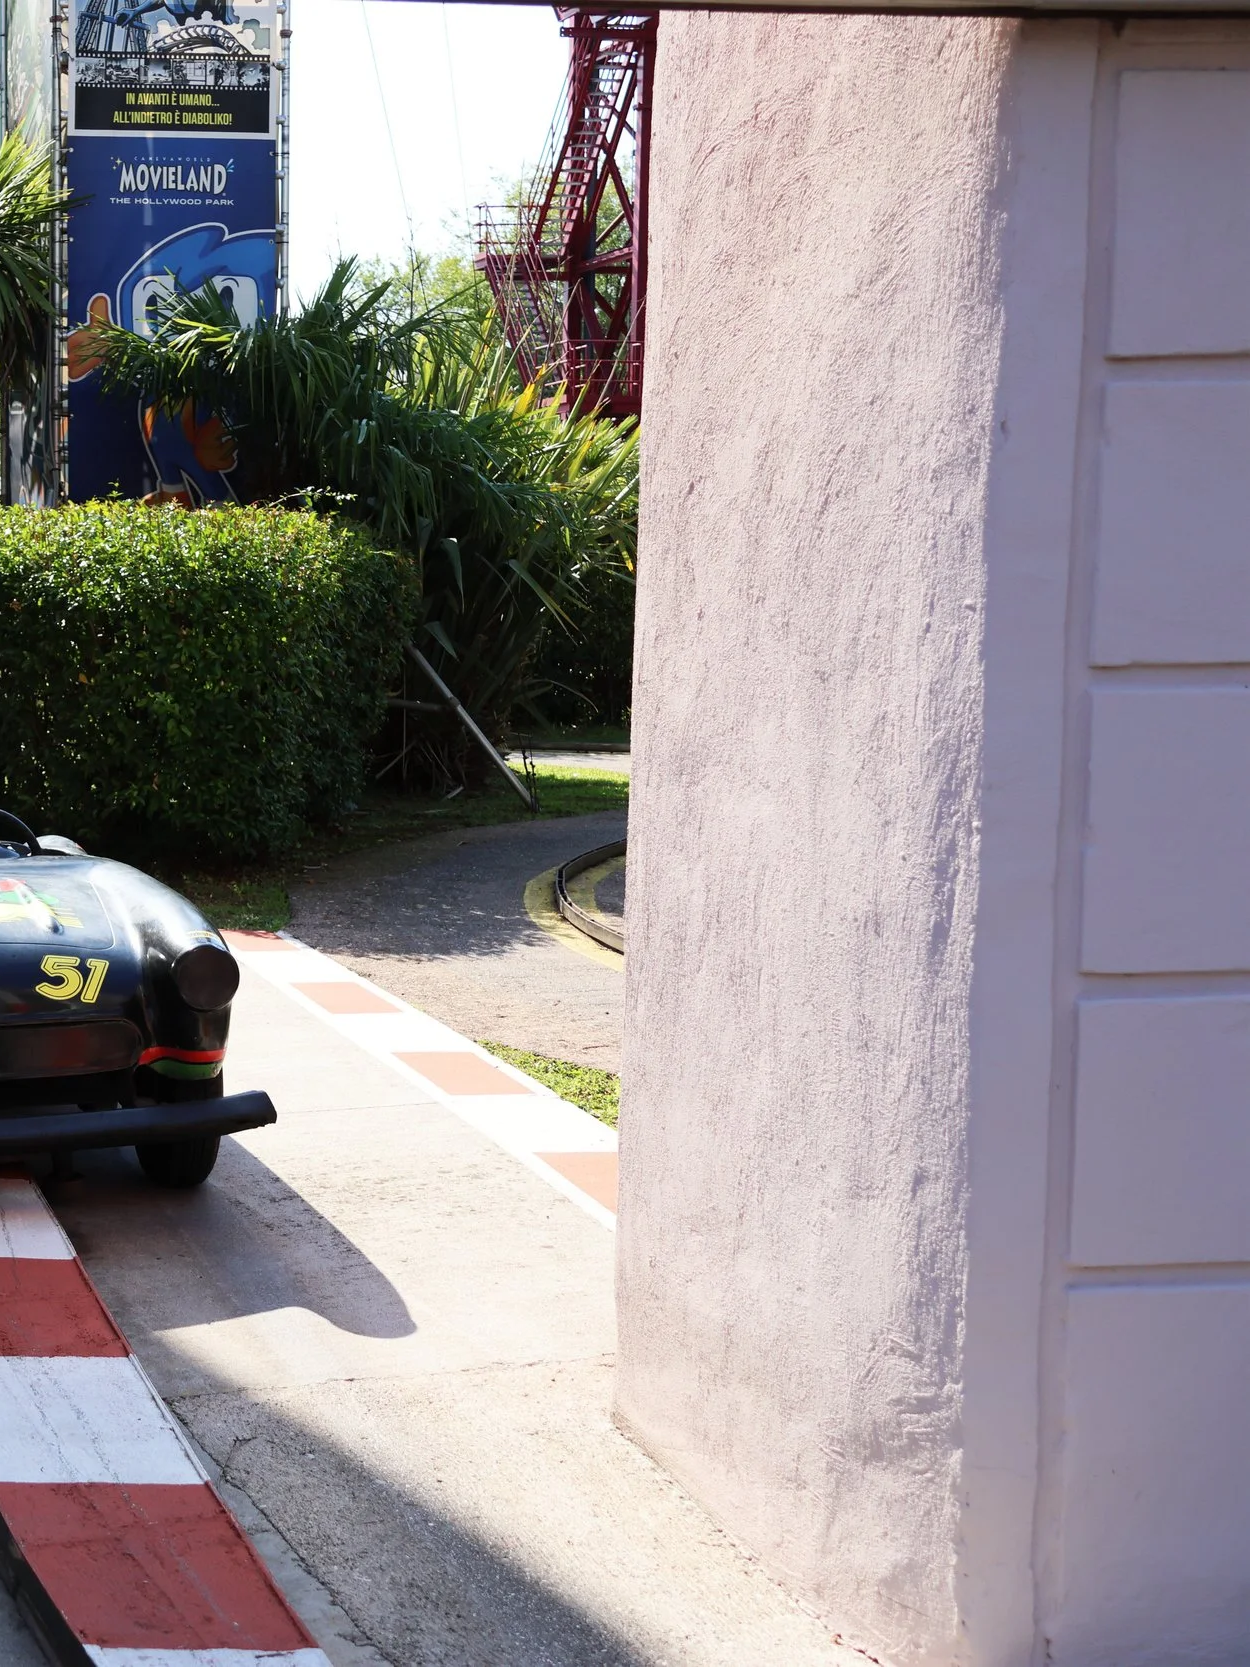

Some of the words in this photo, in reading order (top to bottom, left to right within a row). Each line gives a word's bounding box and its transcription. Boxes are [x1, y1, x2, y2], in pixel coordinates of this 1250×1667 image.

[126, 93, 135, 105] IN
[138, 93, 170, 106] AVANTI
[171, 91, 178, 106] È
[179, 94, 220, 107] UMANO...
[113, 111, 172, 124] ALL'INDIETRO
[175, 109, 181, 124] È
[182, 112, 233, 126] DIABOLIKO!
[119, 163, 227, 194] MOVIELAND
[35, 955, 110, 1004] 51
